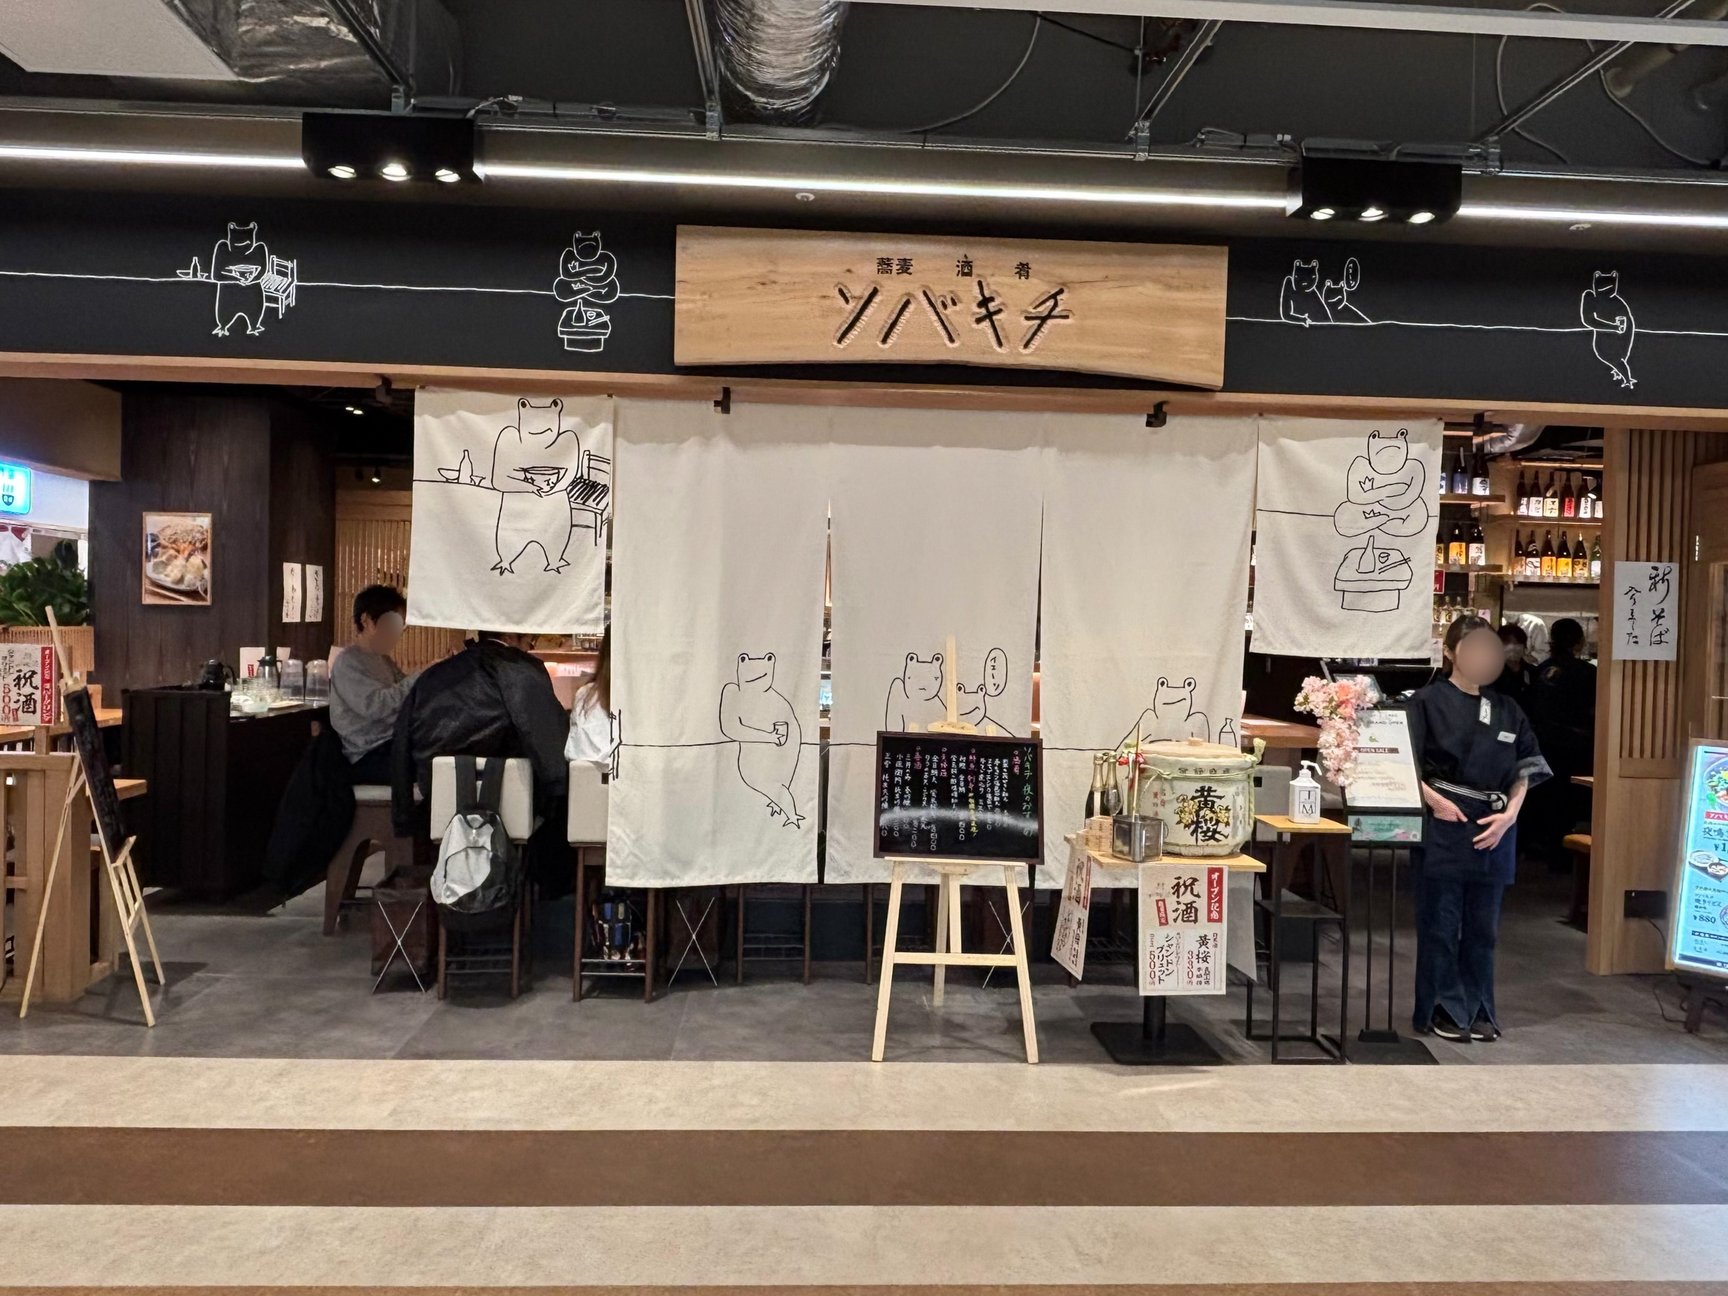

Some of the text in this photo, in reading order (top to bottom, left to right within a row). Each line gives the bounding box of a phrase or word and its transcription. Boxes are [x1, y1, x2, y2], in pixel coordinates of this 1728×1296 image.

[876, 256, 1032, 280] 蕎麦 酒 肴
[835, 280, 1071, 351] ソバキチ
[1648, 565, 1673, 647] 新そば
[13, 668, 40, 715] 祝酒
[1190, 785, 1230, 846] 黄桜
[1171, 876, 1201, 925] 祝酒
[1156, 944, 1166, 985] ブリュット
[1164, 933, 1175, 977] シャンドン
[1195, 934, 1211, 965] 黄桜
